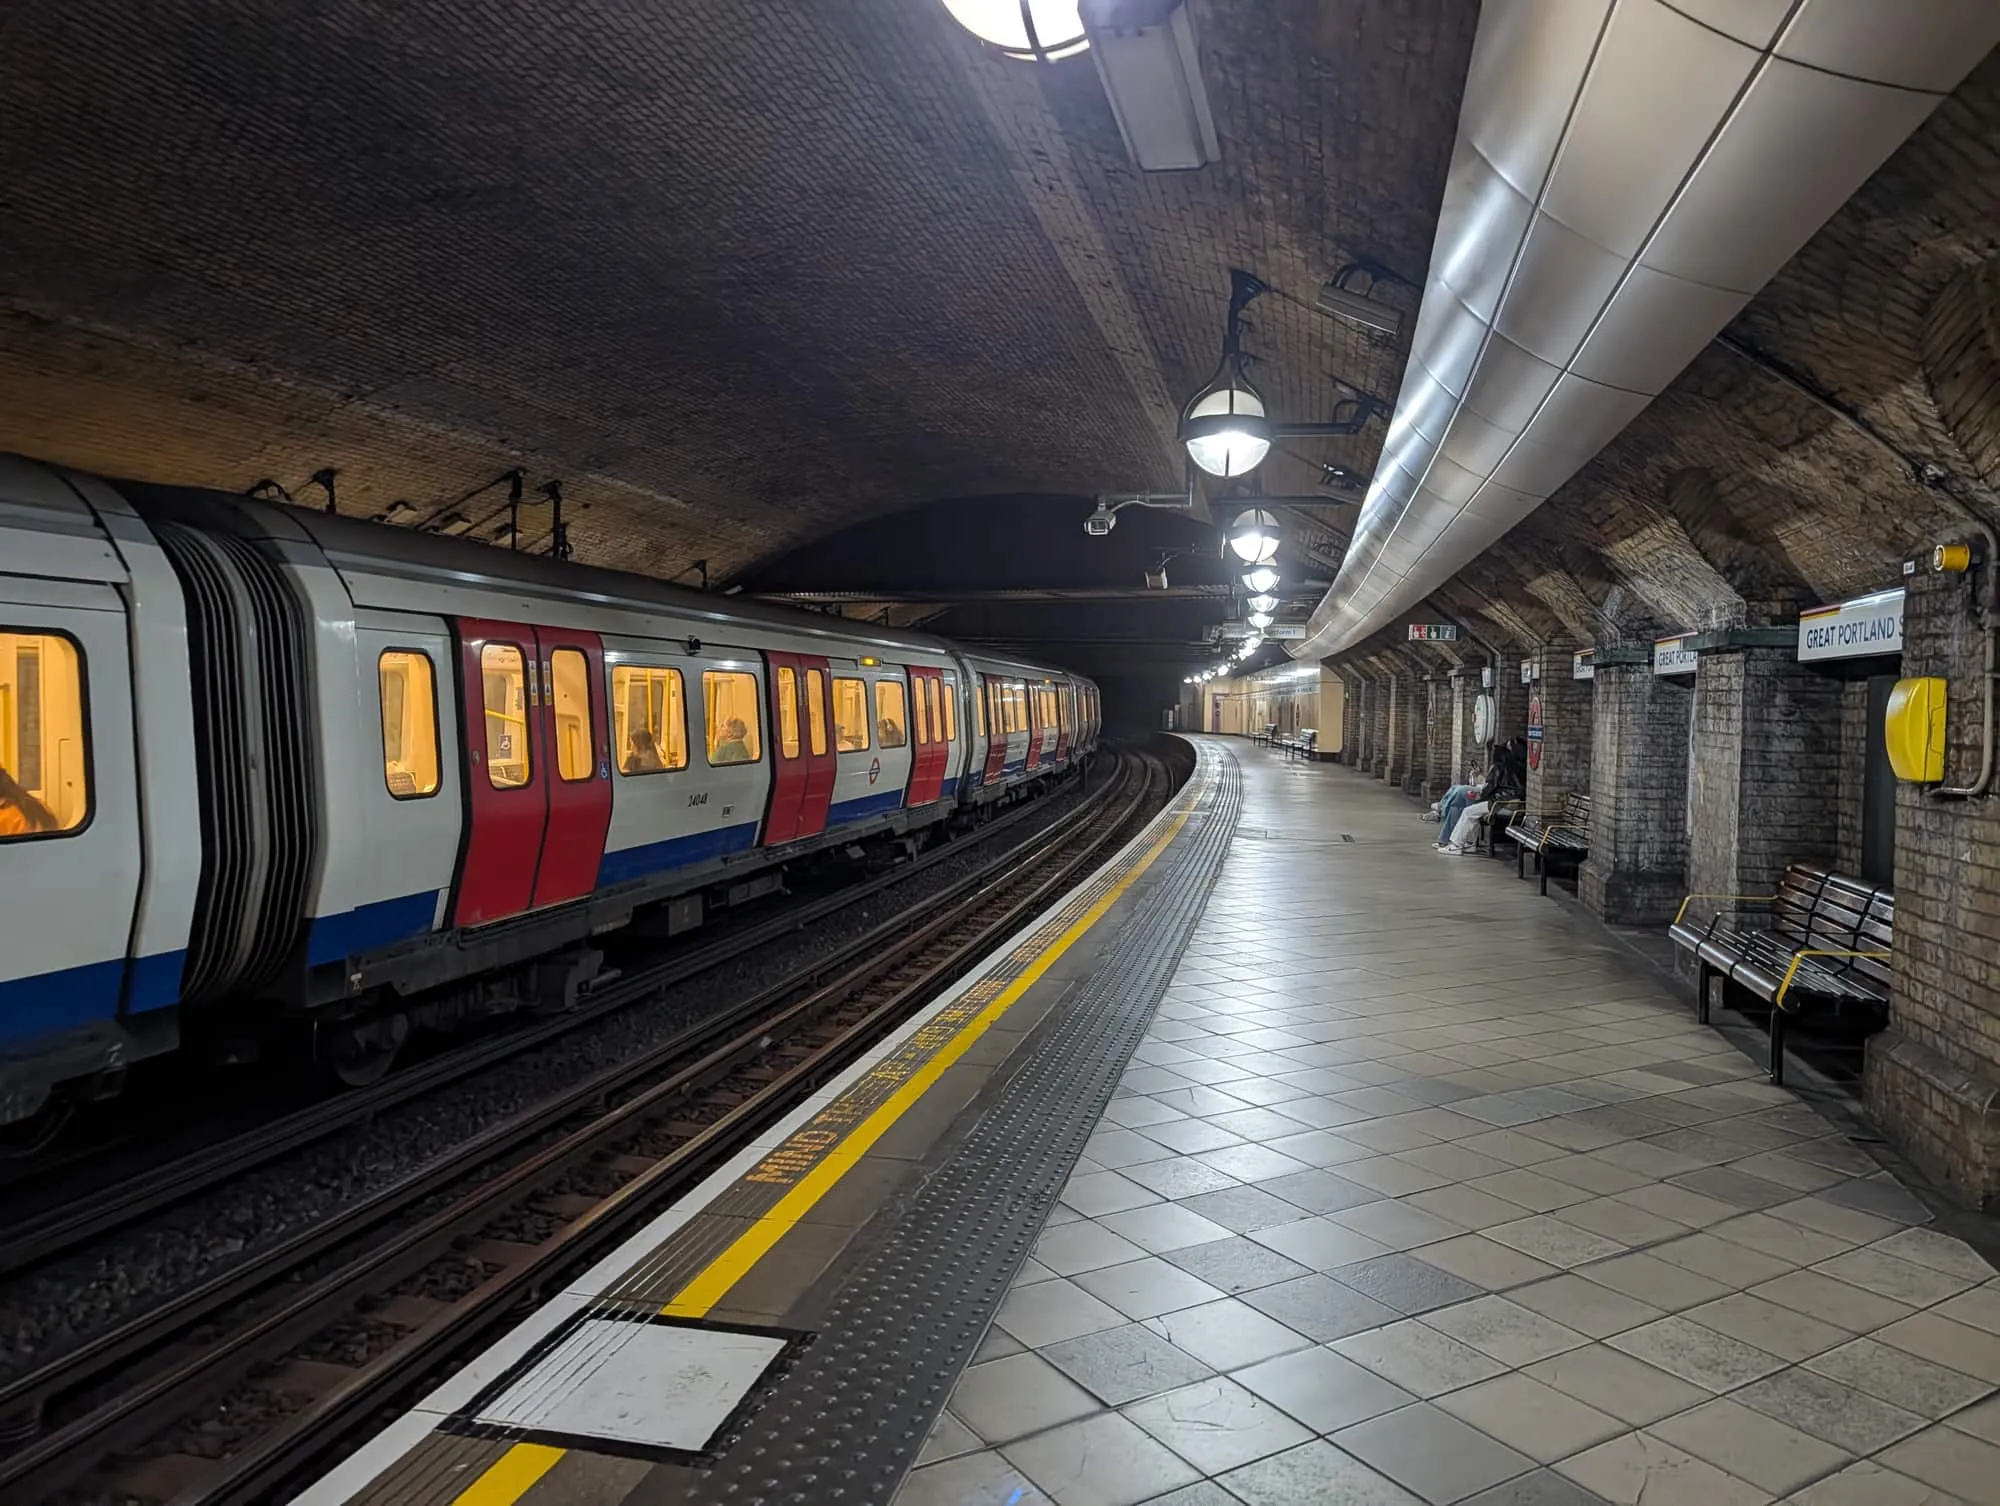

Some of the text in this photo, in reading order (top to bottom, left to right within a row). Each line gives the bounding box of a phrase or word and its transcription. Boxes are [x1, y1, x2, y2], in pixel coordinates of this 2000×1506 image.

[1806, 626, 1836, 649] GREAT
[1838, 617, 1895, 645] PORTLAND
[1658, 650, 1675, 666] GREAT
[745, 1130, 838, 1184] MIND
